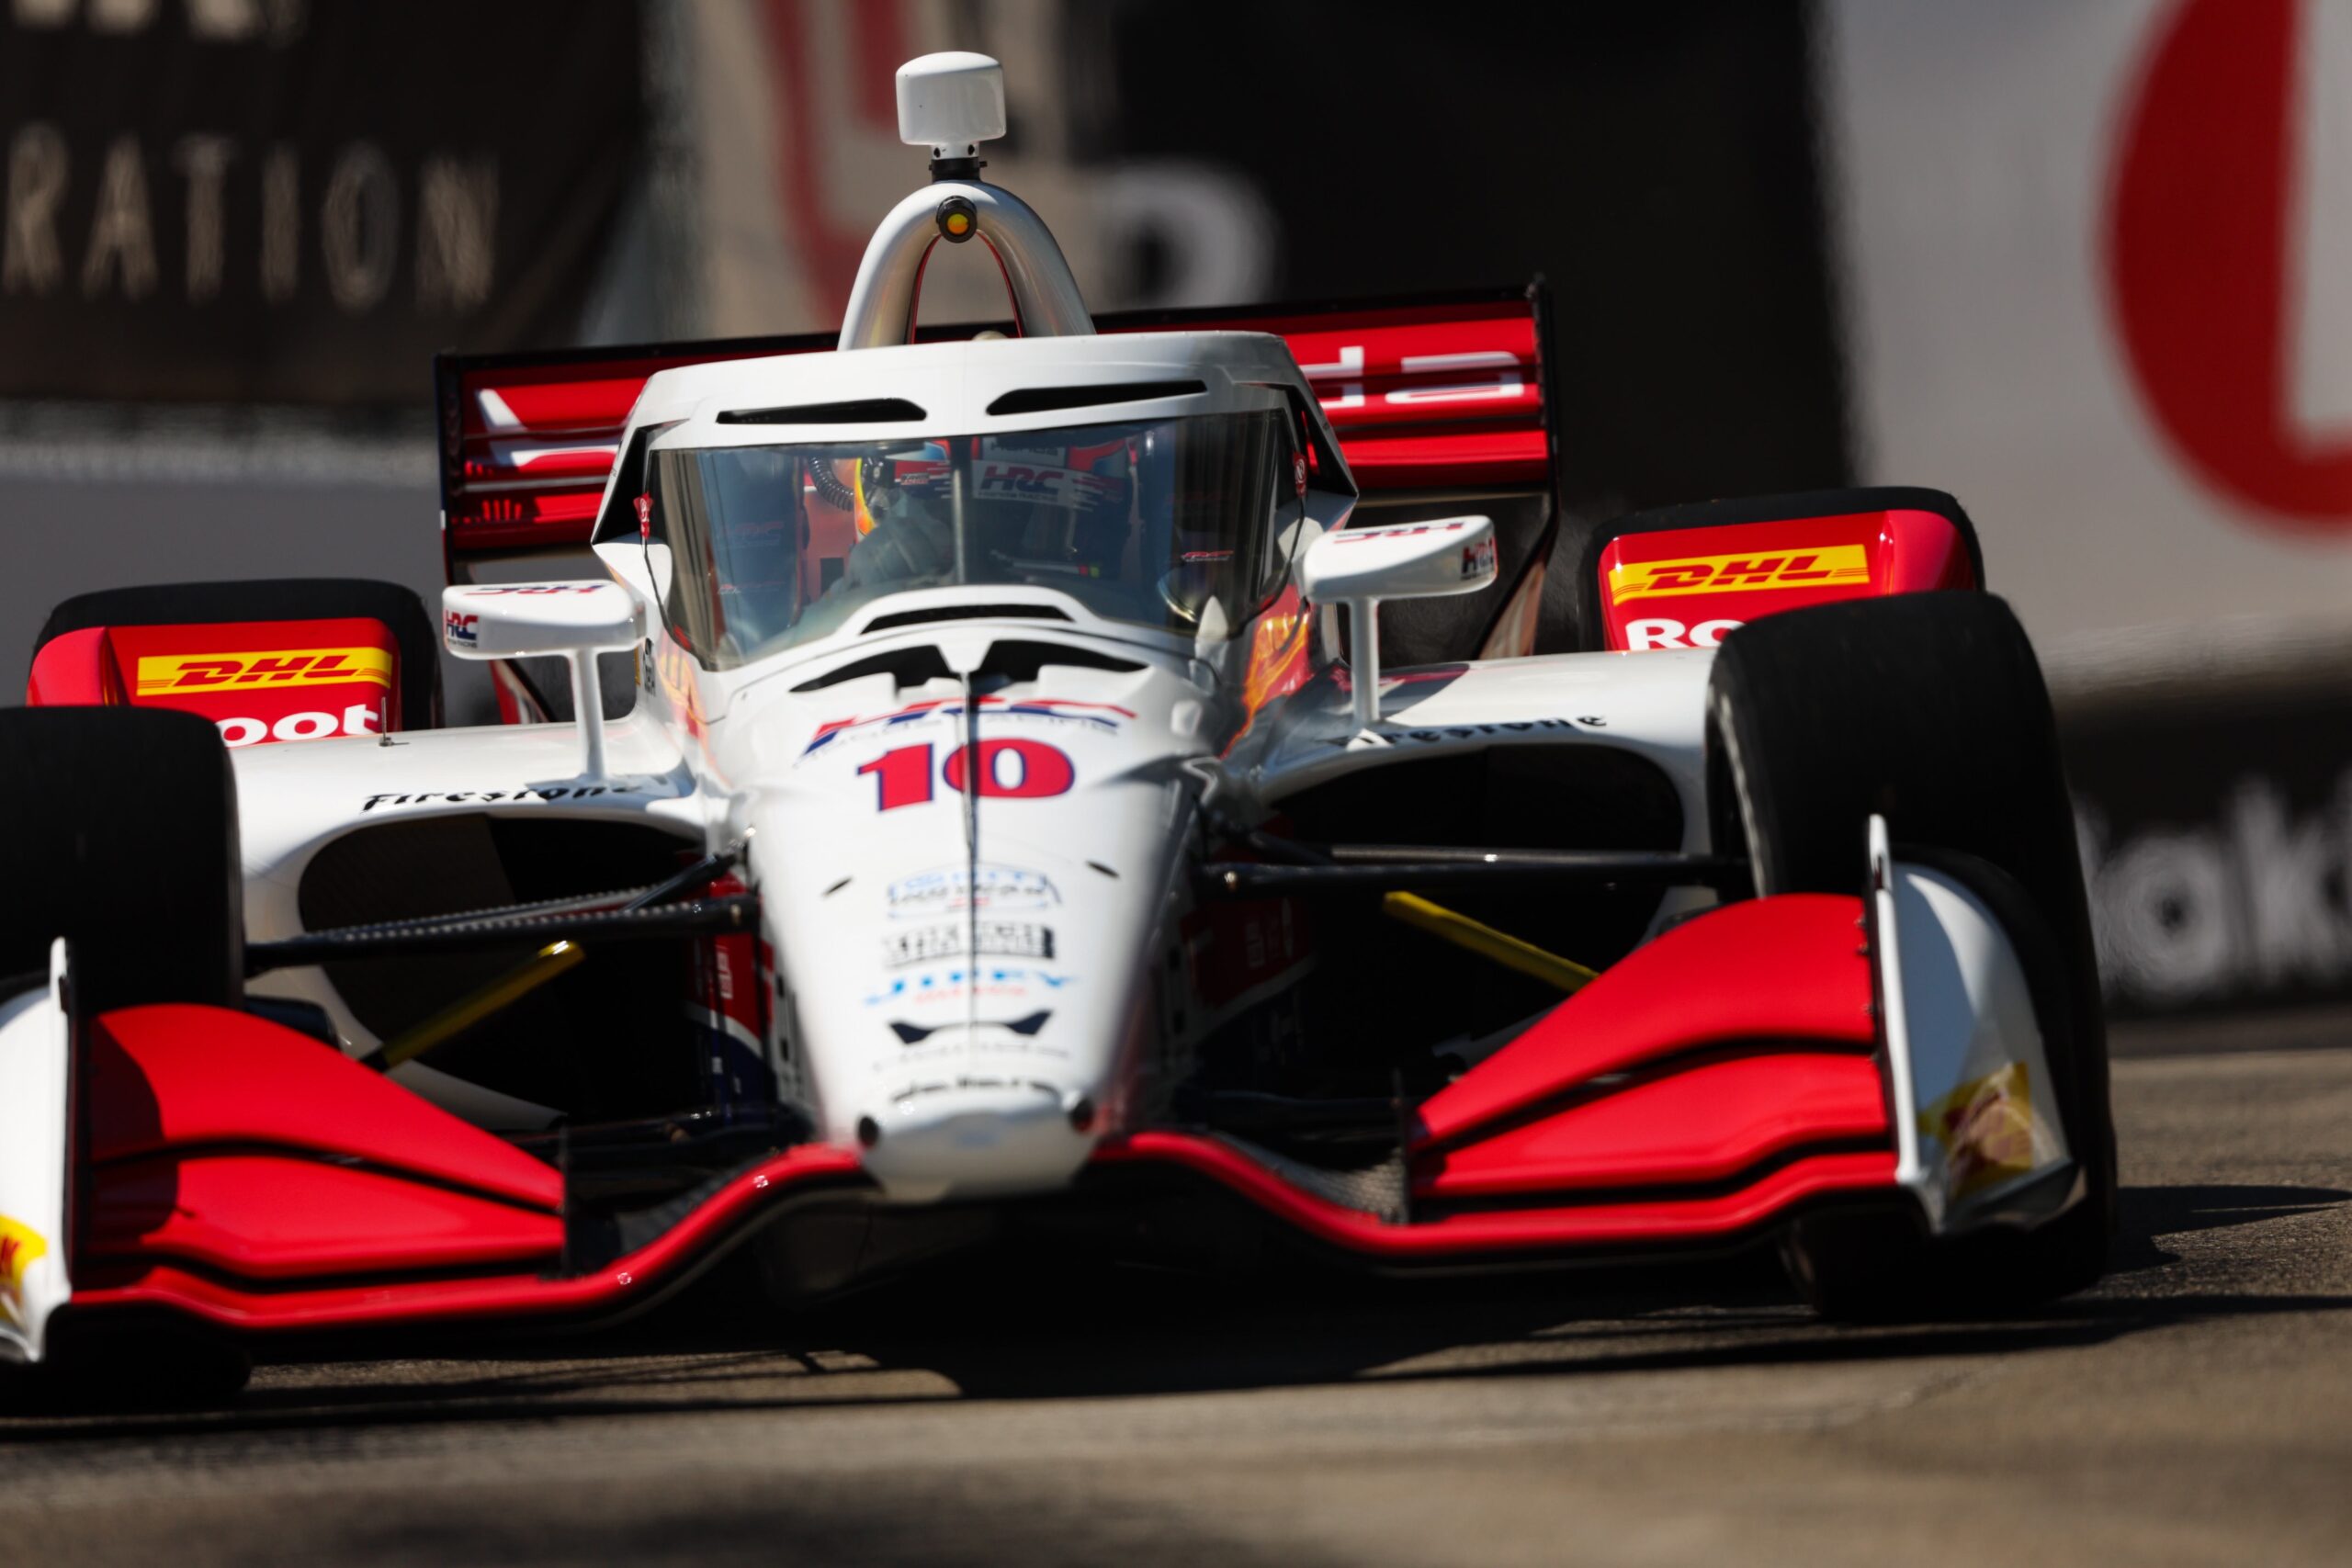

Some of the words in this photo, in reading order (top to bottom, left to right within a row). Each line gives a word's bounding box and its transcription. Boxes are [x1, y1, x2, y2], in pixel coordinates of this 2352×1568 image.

[979, 465, 1064, 495] HRC
[1646, 555, 1833, 591] DHL
[445, 610, 479, 641] HRC
[1625, 617, 1746, 651] Ro
[173, 654, 360, 687] DHL
[214, 703, 379, 748] oot
[857, 737, 1076, 813] 10
[360, 783, 645, 815] Firestone
